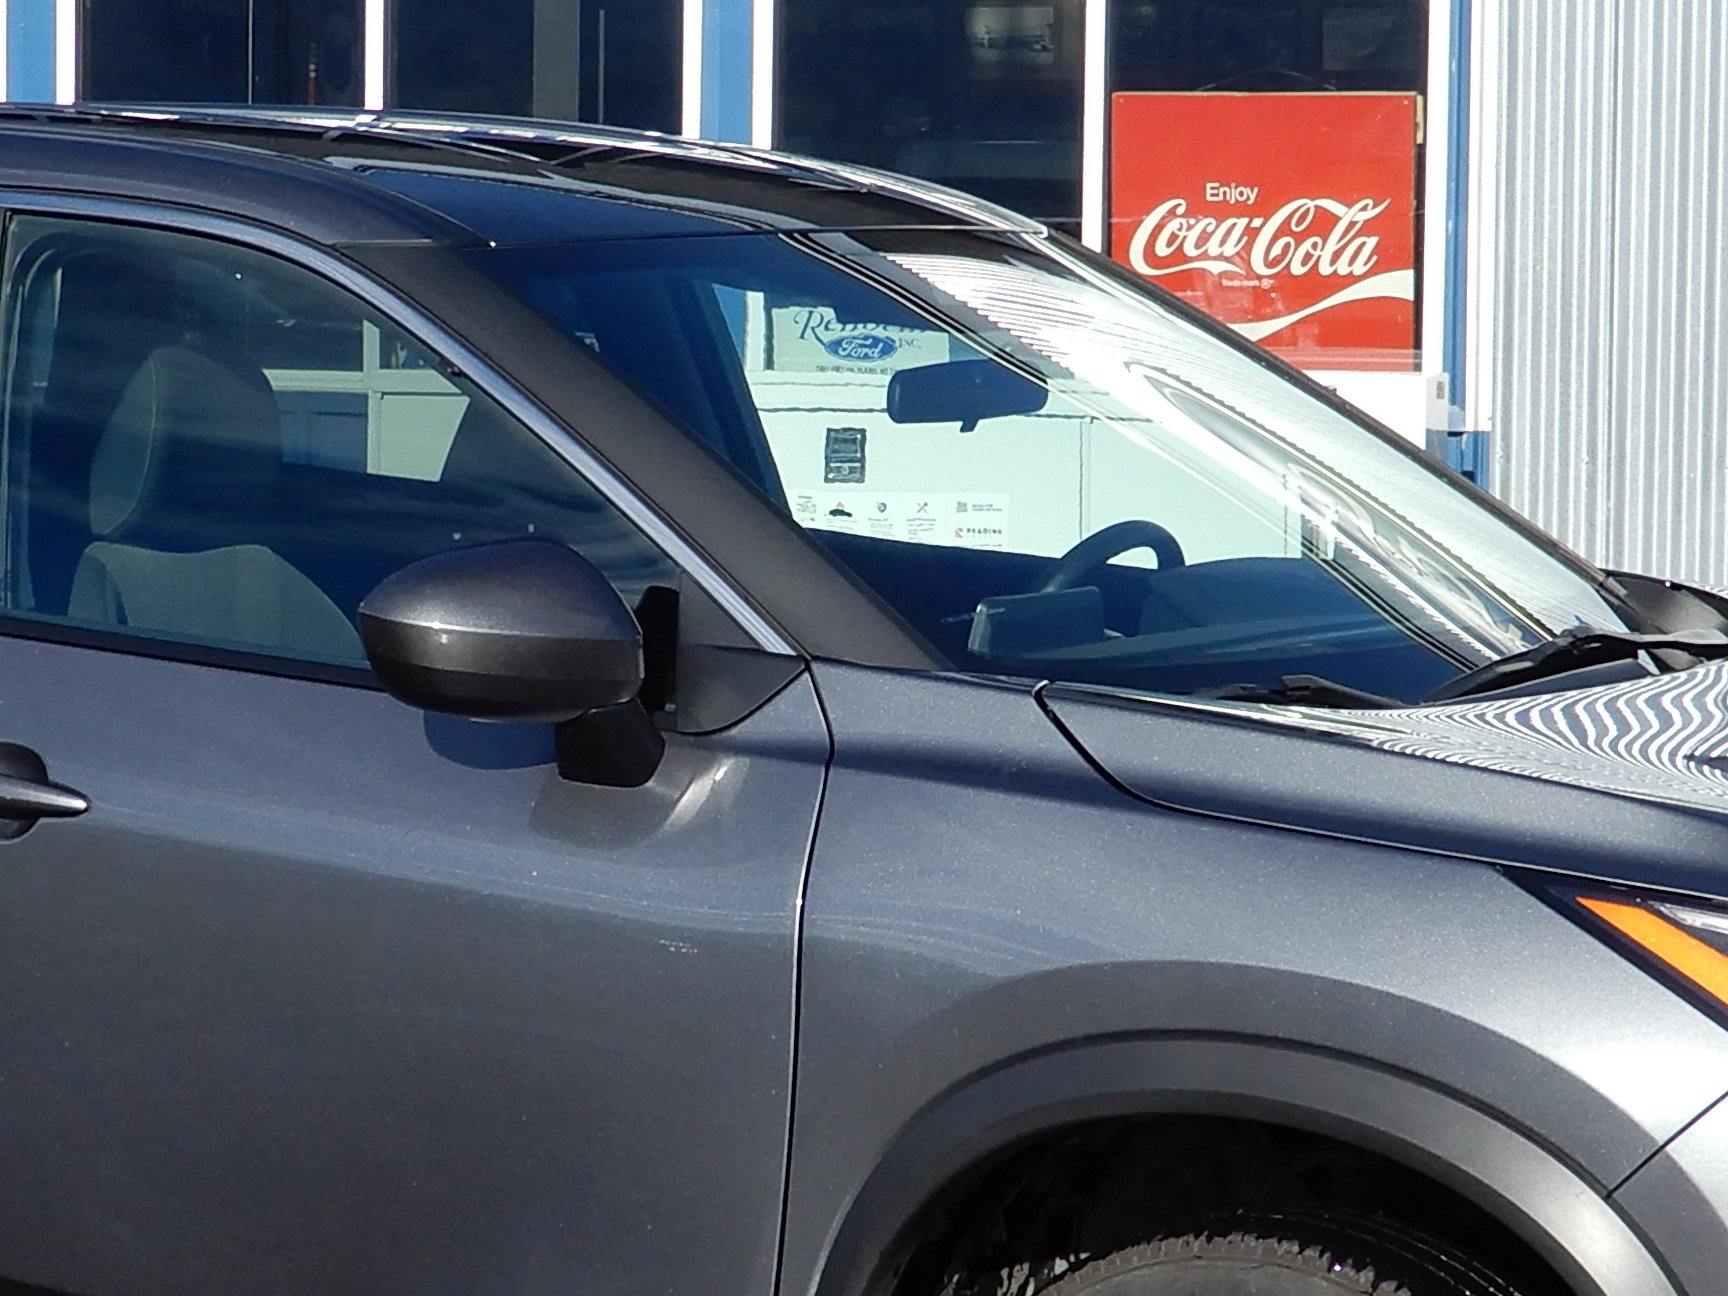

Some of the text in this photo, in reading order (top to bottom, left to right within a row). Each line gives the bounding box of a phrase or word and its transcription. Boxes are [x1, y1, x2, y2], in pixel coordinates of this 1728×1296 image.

[1205, 182, 1259, 204] Enjoy
[1129, 198, 1392, 276] Coca-Cola
[837, 335, 883, 358] Ford
